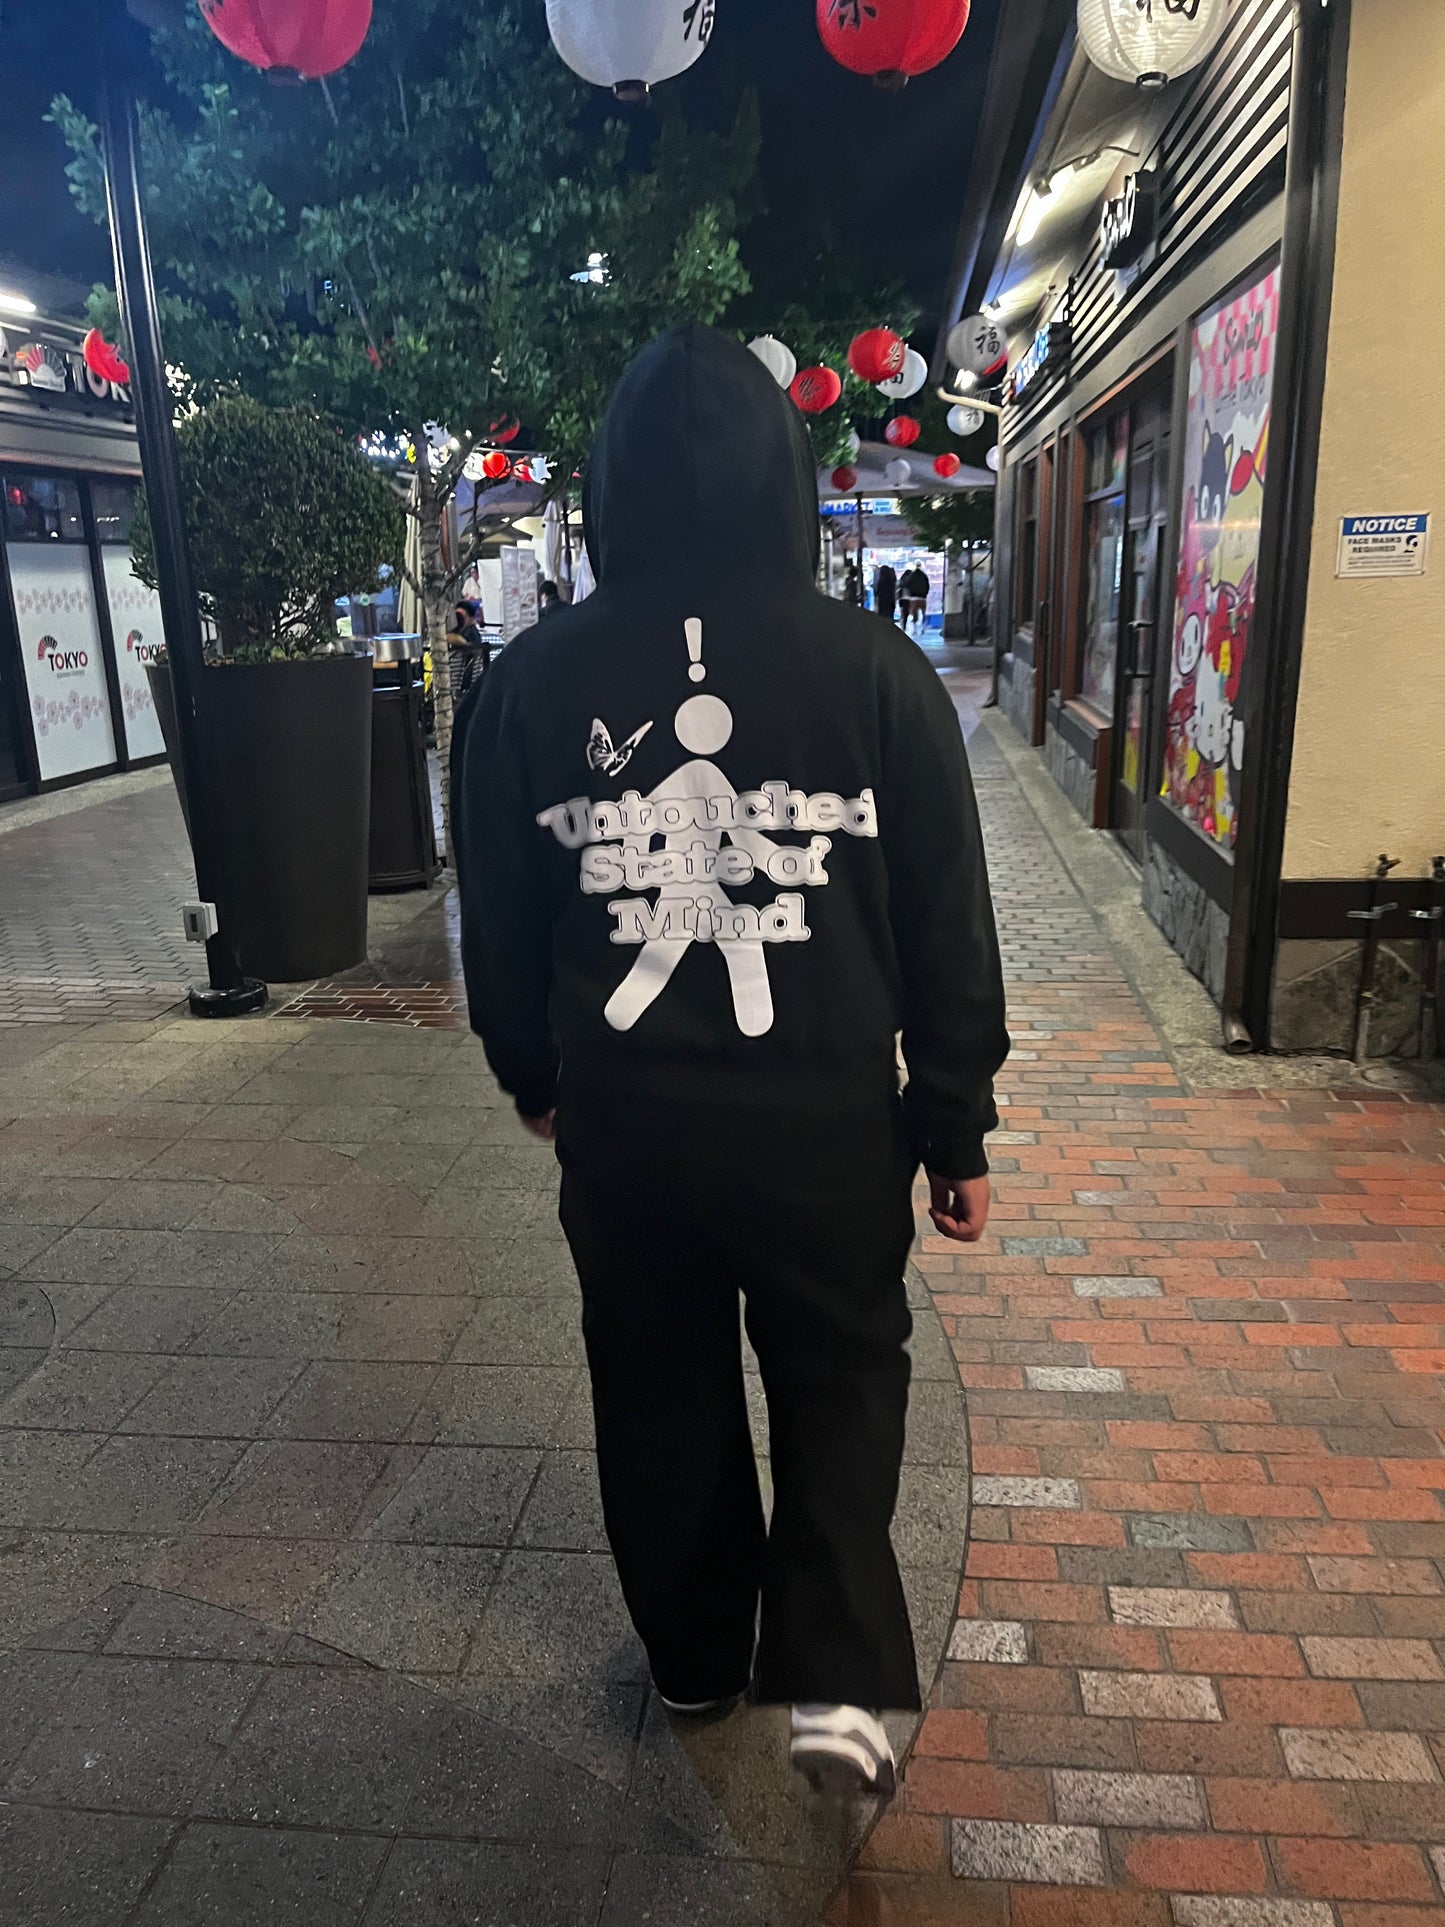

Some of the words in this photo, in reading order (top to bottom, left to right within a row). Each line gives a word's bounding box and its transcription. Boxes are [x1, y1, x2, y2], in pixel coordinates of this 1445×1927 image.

[1351, 517, 1418, 533] NOTICE
[1372, 536, 1402, 544] MASKS
[47, 650, 88, 672] TOKYO
[535, 780, 878, 849] Untouched
[579, 840, 755, 893] State
[766, 835, 833, 887] of
[608, 893, 811, 943] Mind
